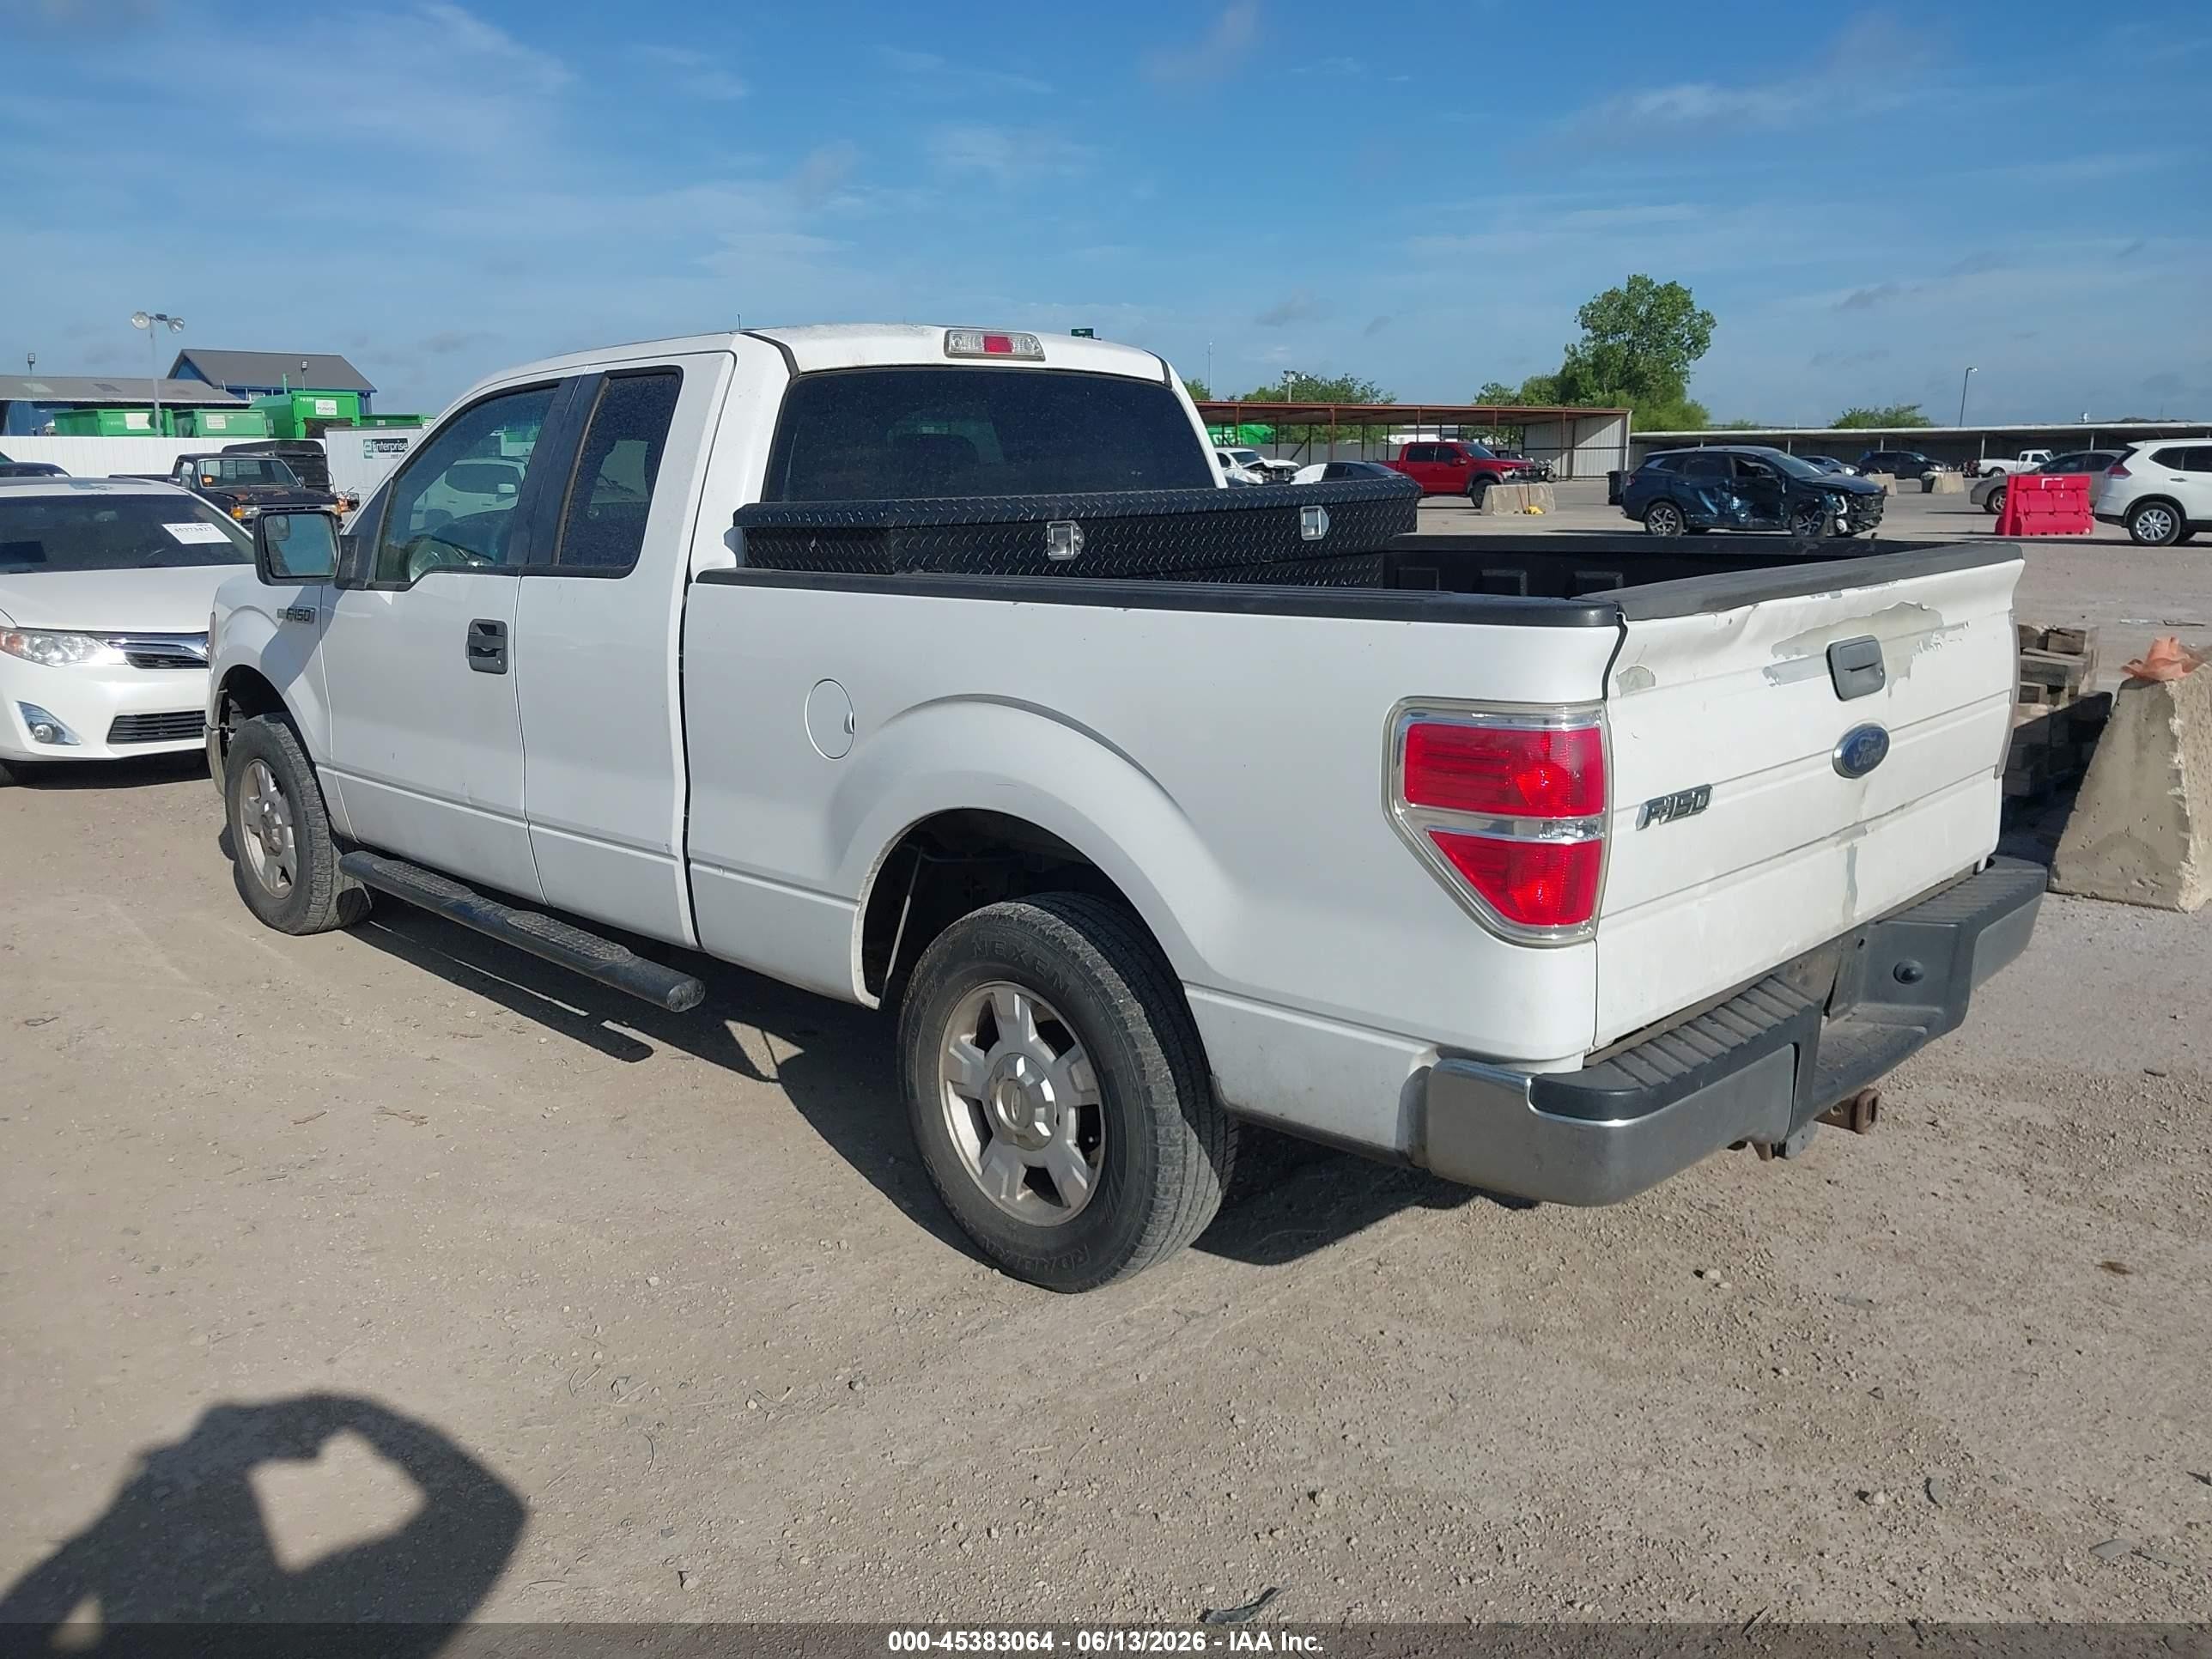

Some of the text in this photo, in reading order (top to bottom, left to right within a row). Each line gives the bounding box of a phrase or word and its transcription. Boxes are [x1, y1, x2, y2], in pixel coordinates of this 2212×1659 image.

[372, 440, 408, 453] Enterprise
[1853, 734, 1884, 768] Ford
[970, 939, 1072, 997] NEXEN
